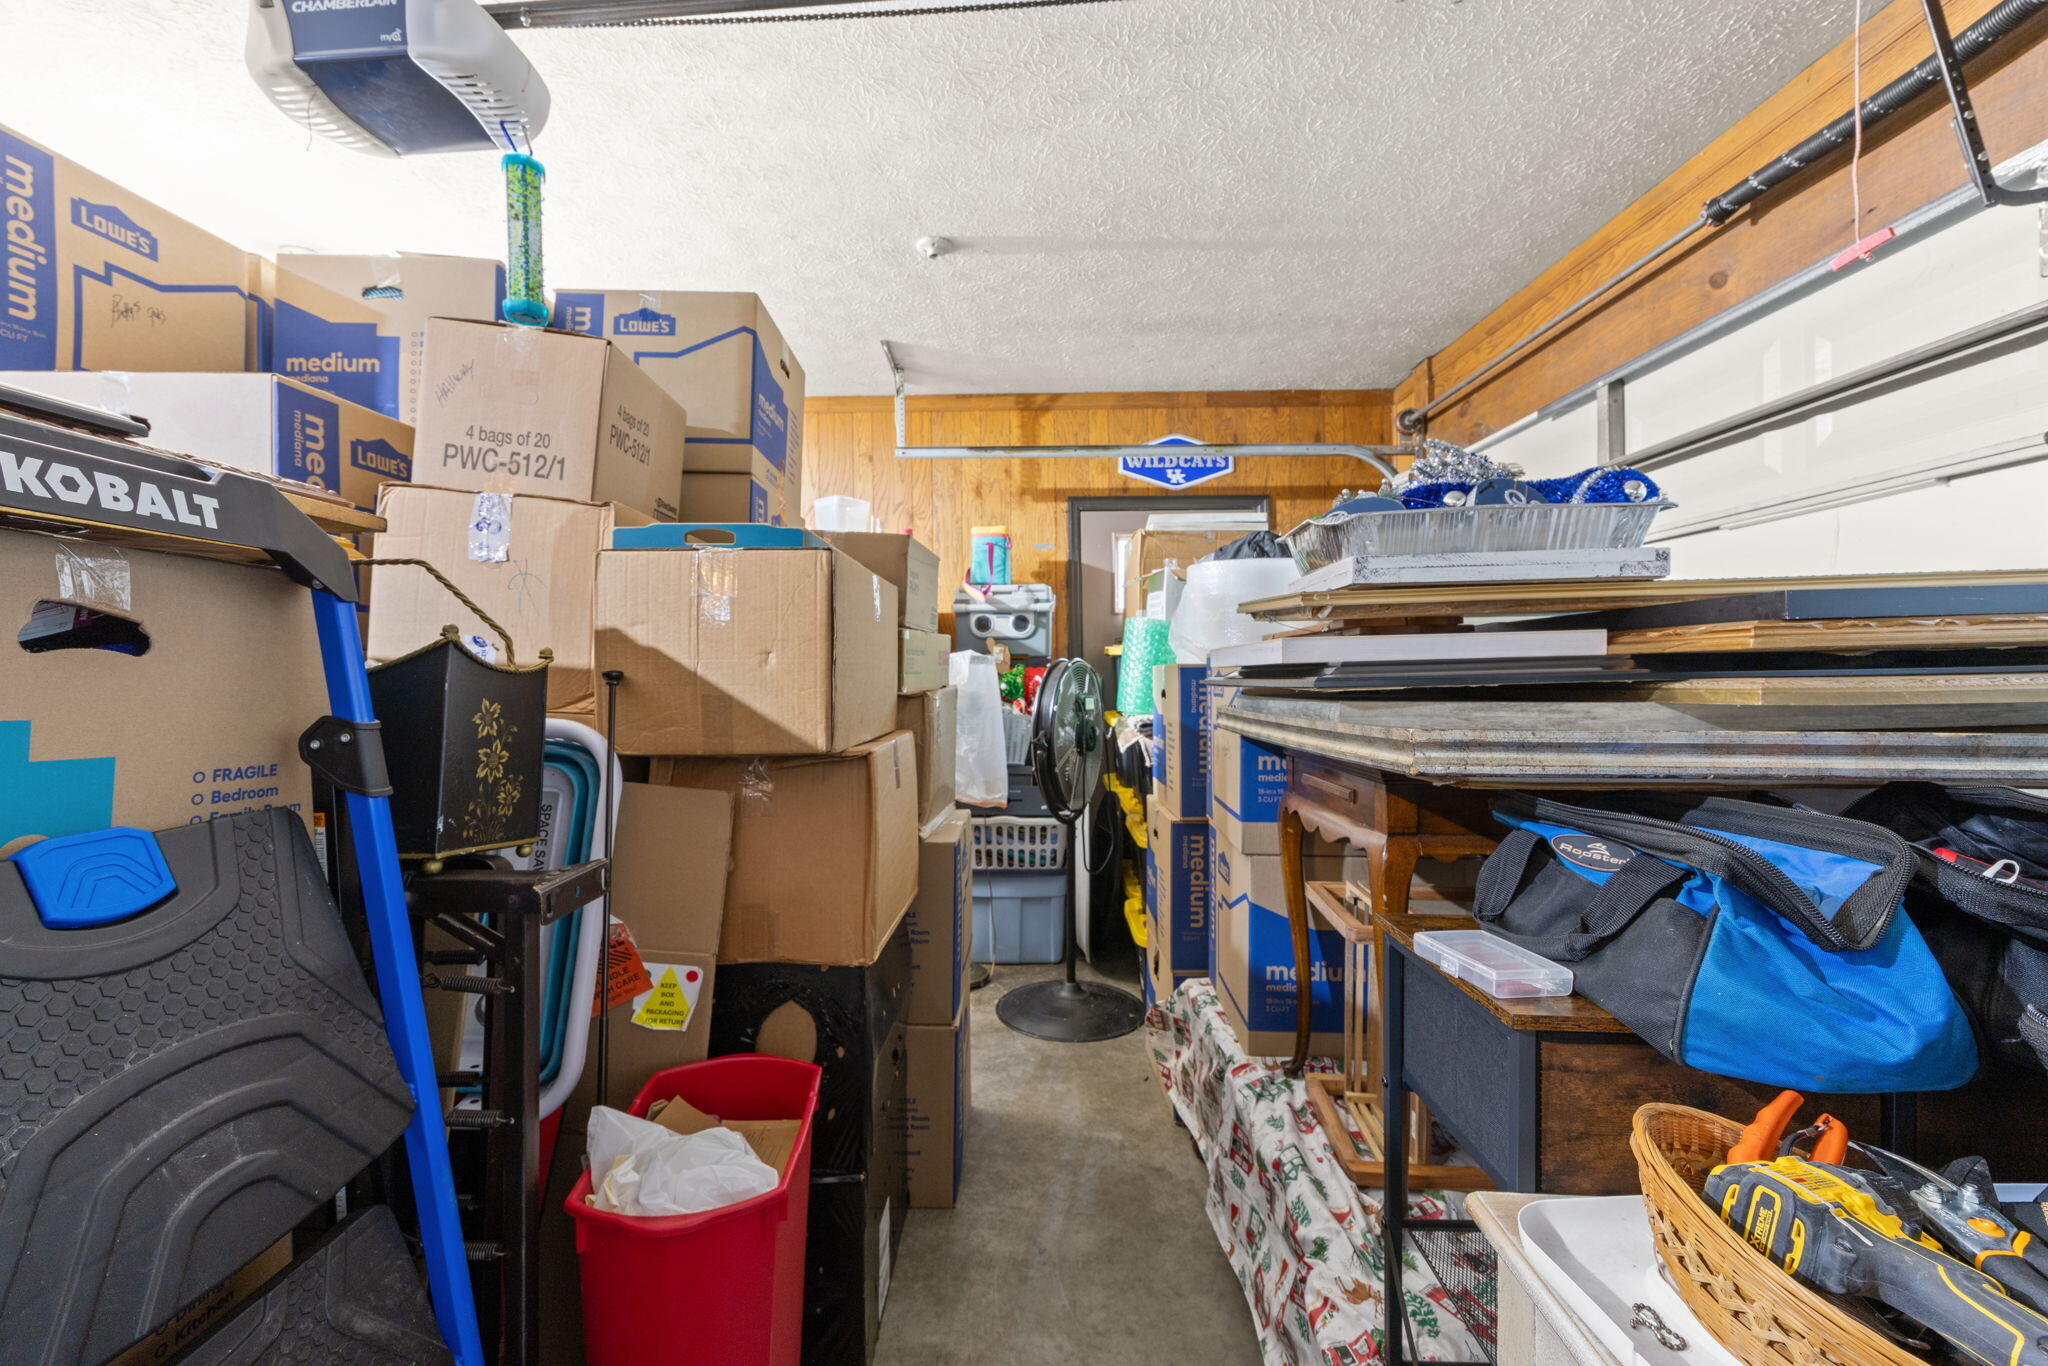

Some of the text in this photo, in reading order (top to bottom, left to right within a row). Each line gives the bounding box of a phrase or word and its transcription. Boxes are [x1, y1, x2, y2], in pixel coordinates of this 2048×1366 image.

[5, 154, 48, 322] medium
[80, 205, 152, 254] LOWE'S
[619, 318, 670, 334] LOWE'S
[286, 352, 380, 373] medium
[466, 425, 551, 449] 4 bags of 20
[357, 445, 408, 478] LOWE'S
[443, 443, 566, 481] PWC-512/1
[1125, 455, 1217, 468] WILDCATS
[0, 451, 220, 530] KOBALT
[212, 764, 278, 782] FRAGILE
[211, 786, 279, 804] Bedroom
[537, 804, 553, 847] SPACE
[1560, 842, 1626, 865] Rooster
[1189, 836, 1210, 928] medium
[615, 974, 640, 990] CARE
